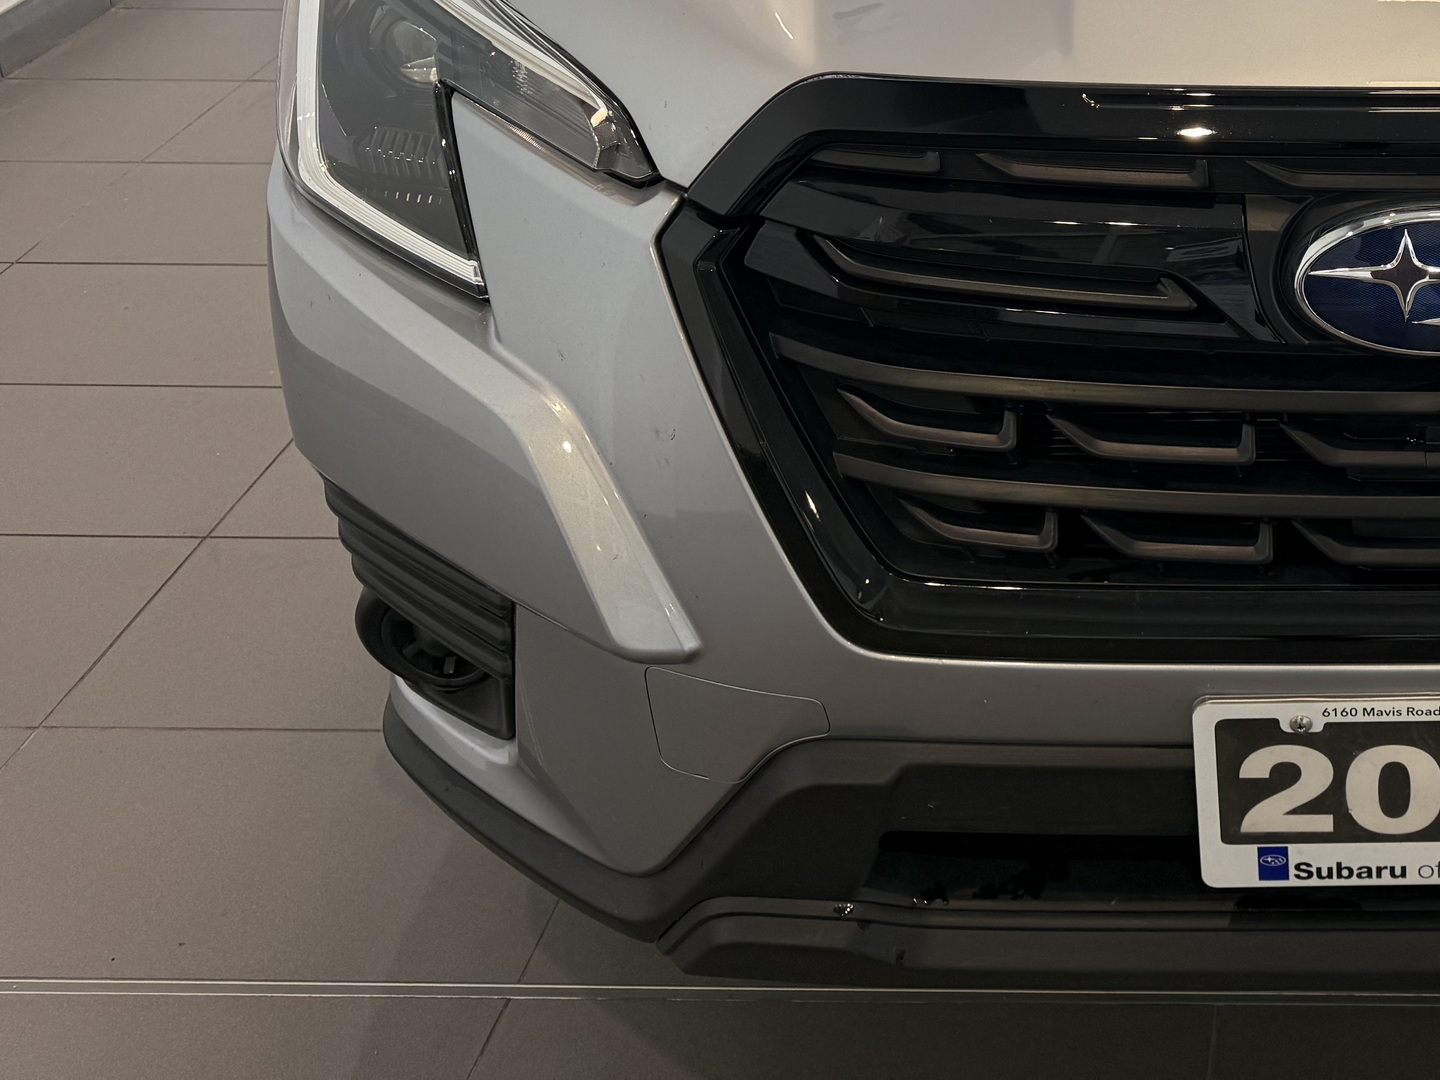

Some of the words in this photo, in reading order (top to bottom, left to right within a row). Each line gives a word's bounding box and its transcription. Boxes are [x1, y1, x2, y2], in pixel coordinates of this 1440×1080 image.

[1321, 707, 1358, 718] 6160
[1362, 706, 1403, 717] Mavis
[1293, 861, 1407, 880] Subaru
